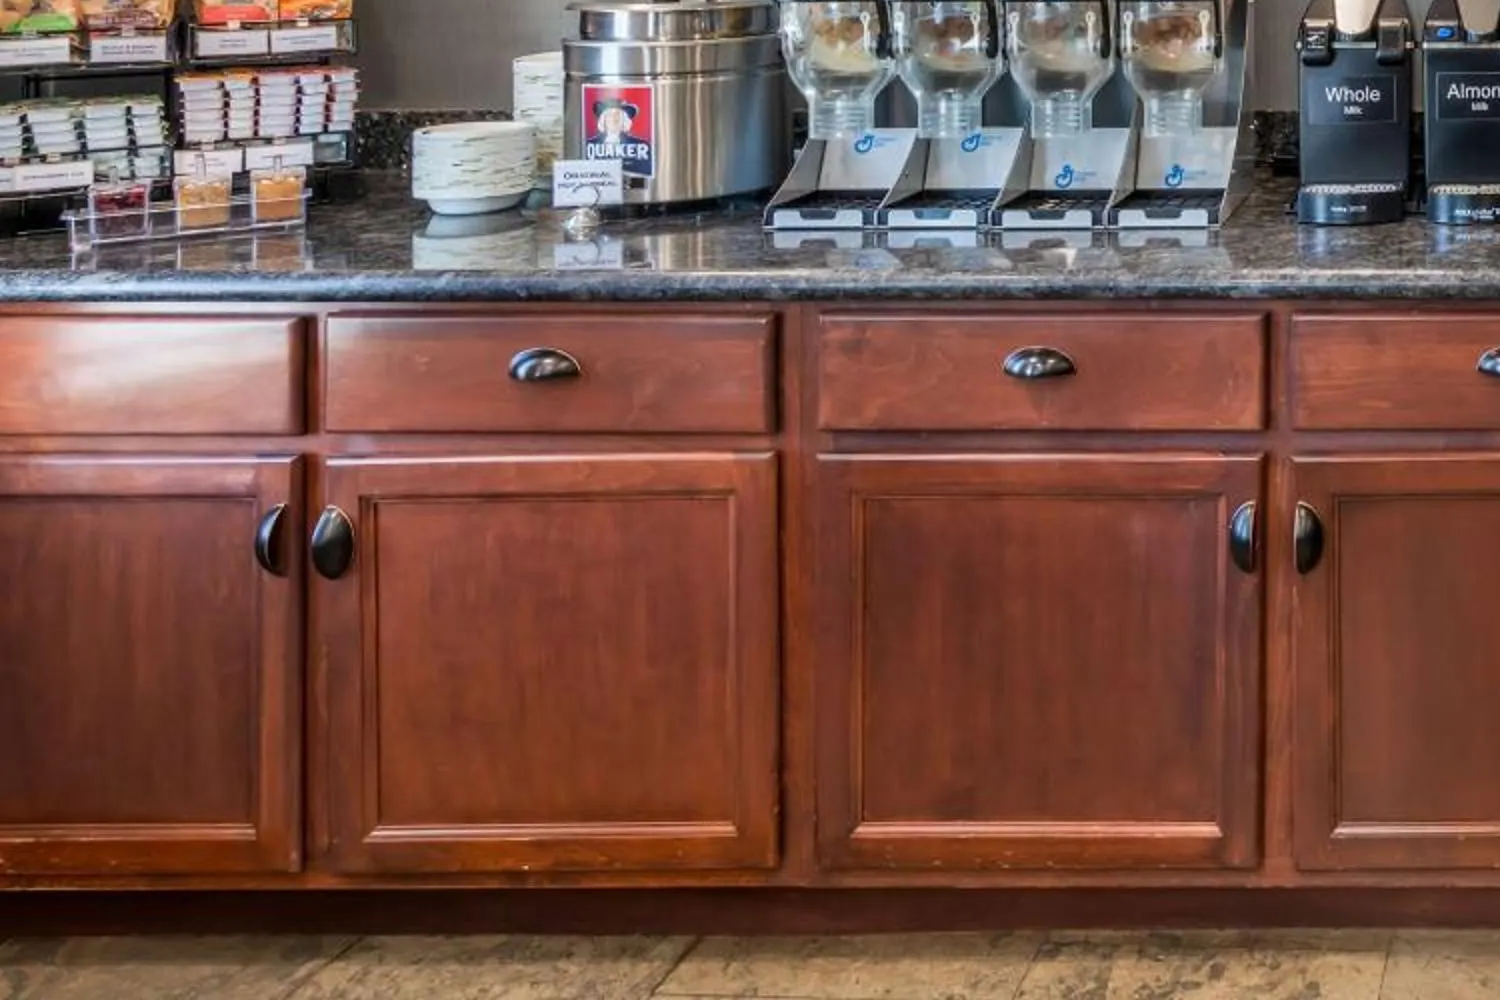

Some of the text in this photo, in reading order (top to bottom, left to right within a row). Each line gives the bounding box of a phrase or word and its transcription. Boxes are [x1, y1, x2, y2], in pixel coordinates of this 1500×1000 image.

[1324, 85, 1381, 102] Whole
[1471, 101, 1489, 112] Milk
[587, 143, 649, 160] QUAKER
